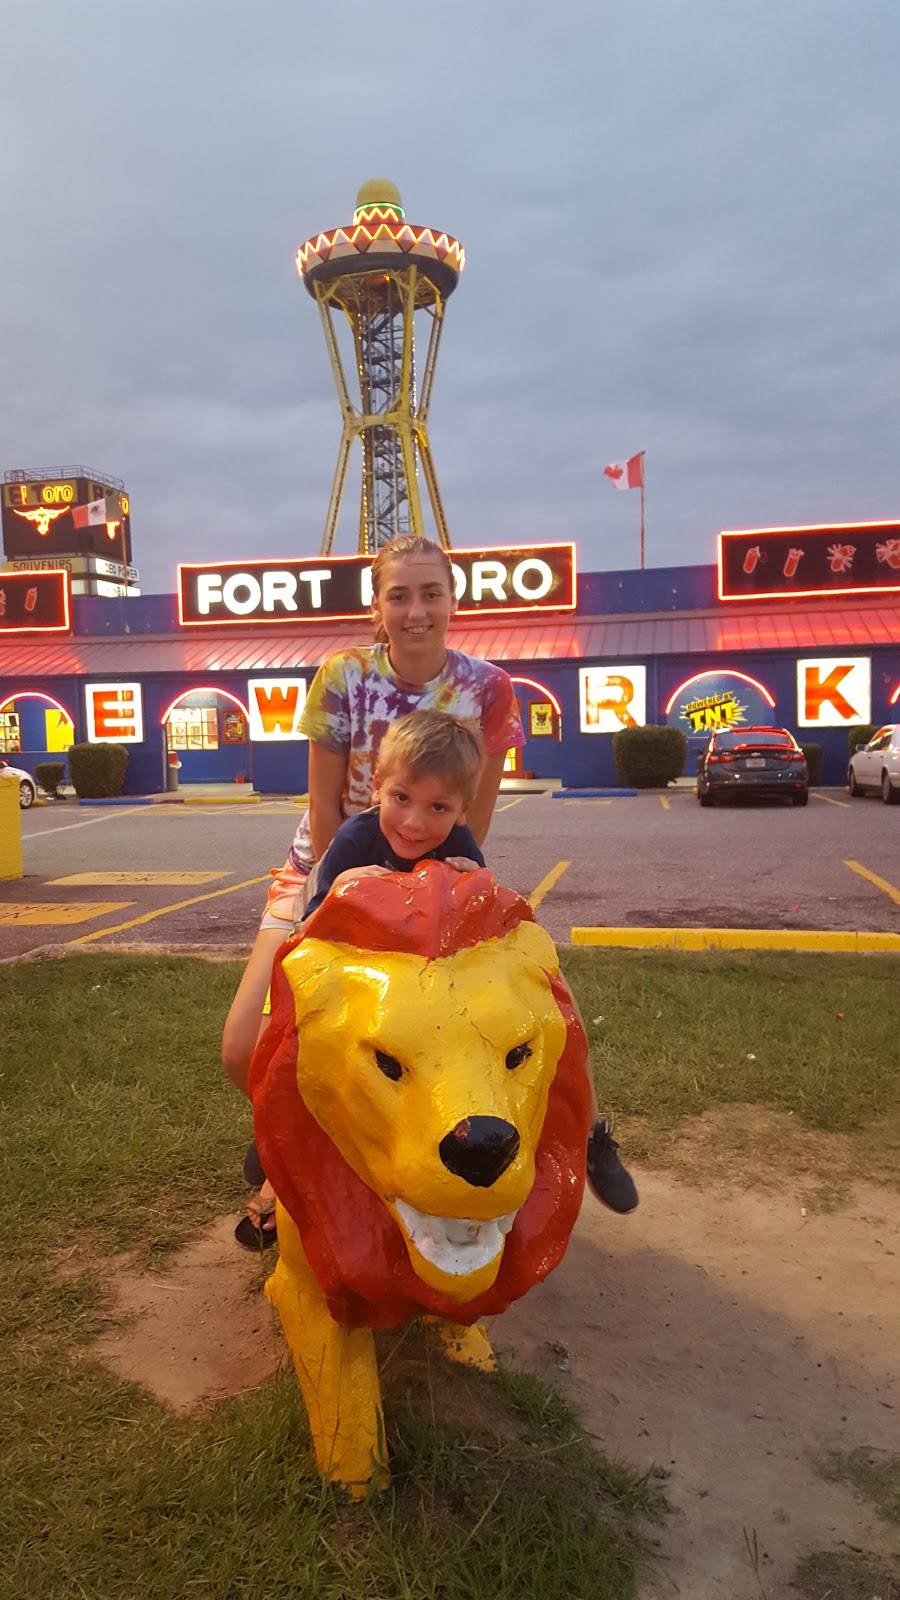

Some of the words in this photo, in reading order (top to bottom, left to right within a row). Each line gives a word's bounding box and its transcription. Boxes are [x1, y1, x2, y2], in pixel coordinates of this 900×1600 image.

[196, 570, 332, 615] FORT
[93, 690, 136, 737] E
[255, 686, 299, 733] W
[585, 675, 637, 728] R
[804, 664, 861, 720] K
[687, 697, 721, 710] POWERED
[723, 693, 734, 701] BY
[690, 702, 737, 731] TNT
